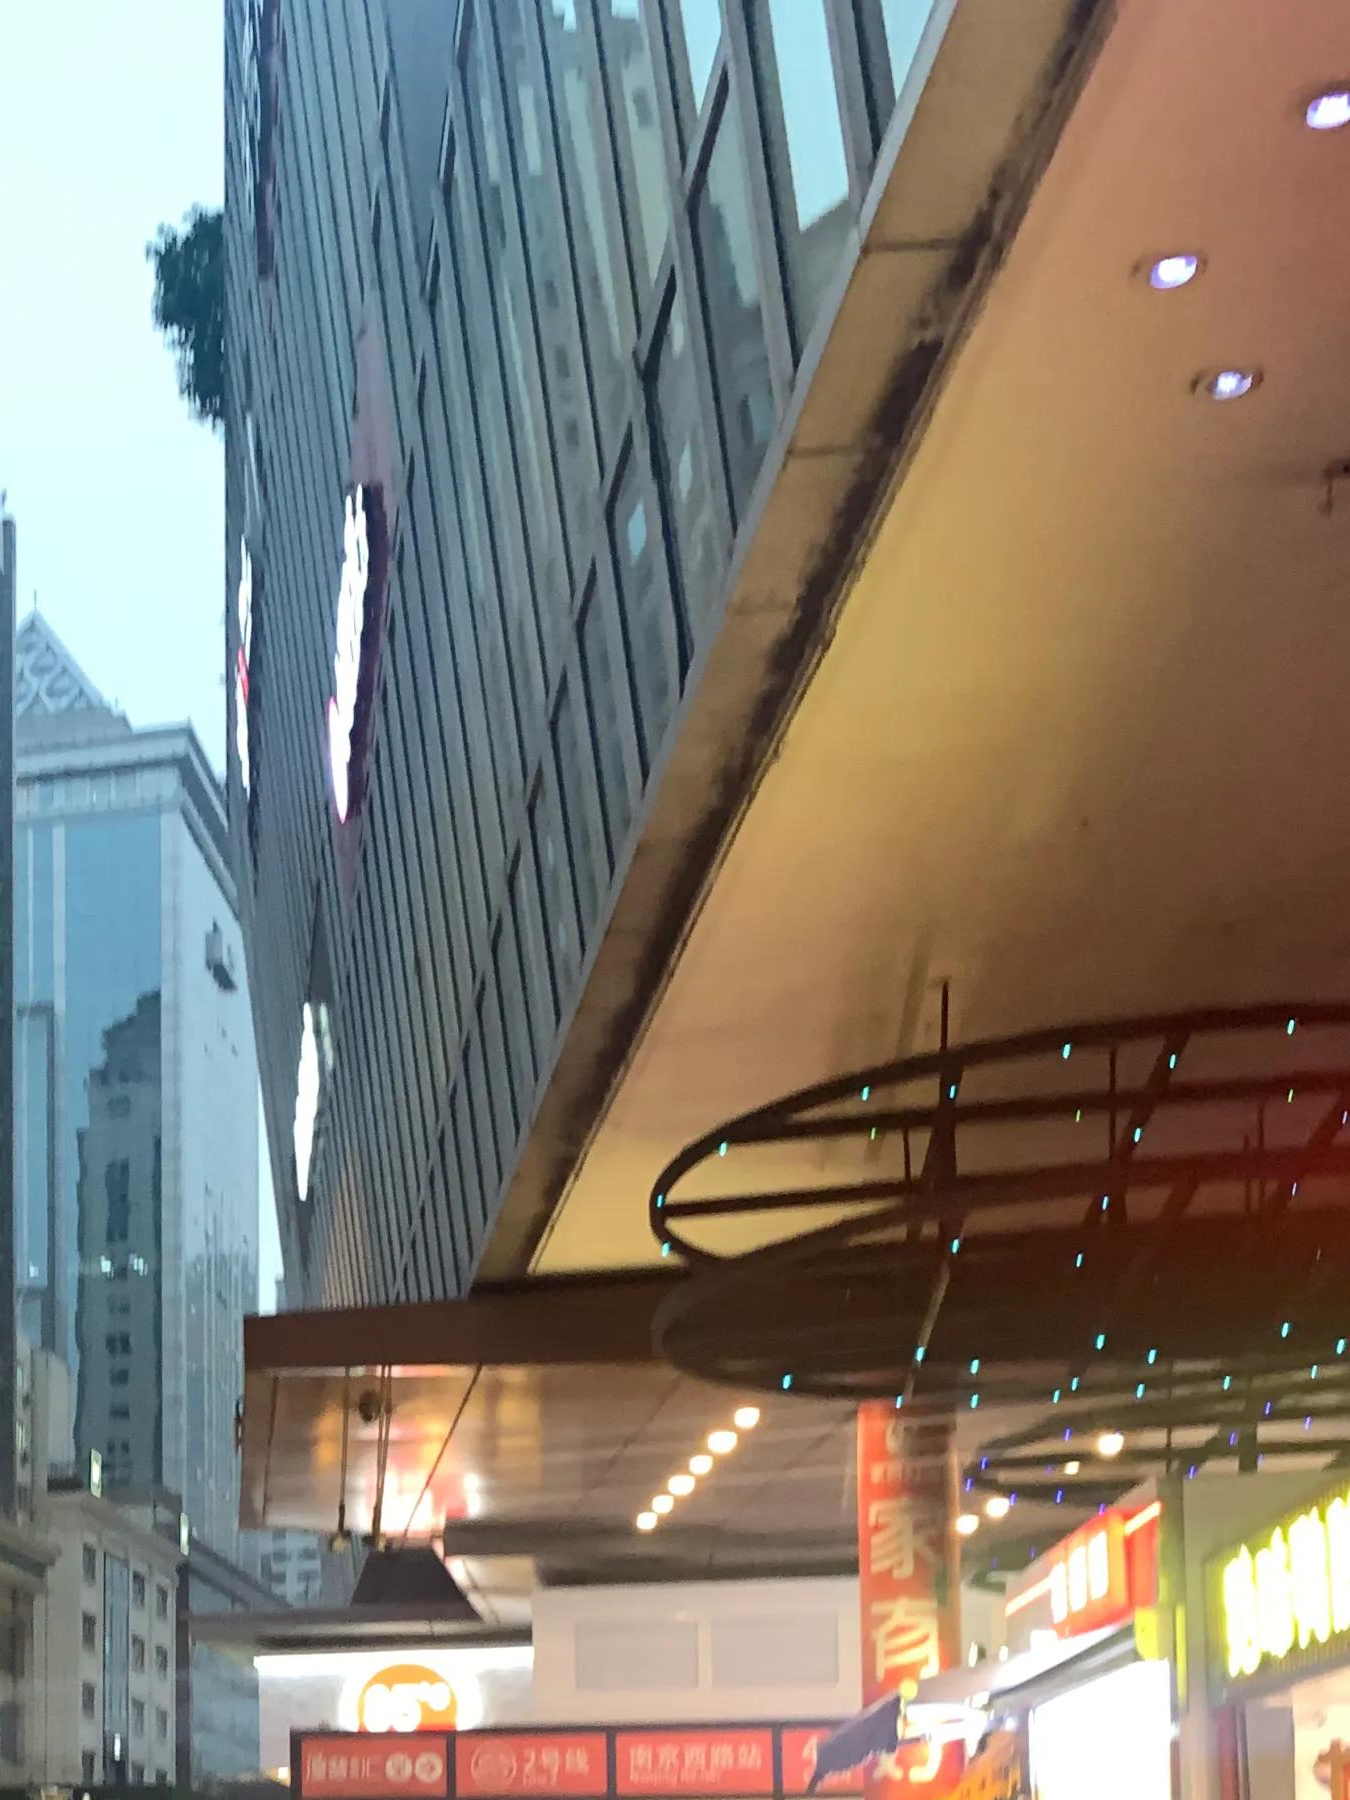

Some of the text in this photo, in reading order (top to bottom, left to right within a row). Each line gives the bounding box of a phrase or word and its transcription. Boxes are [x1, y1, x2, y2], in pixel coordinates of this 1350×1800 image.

[629, 1741, 762, 1771] 南京西路站
